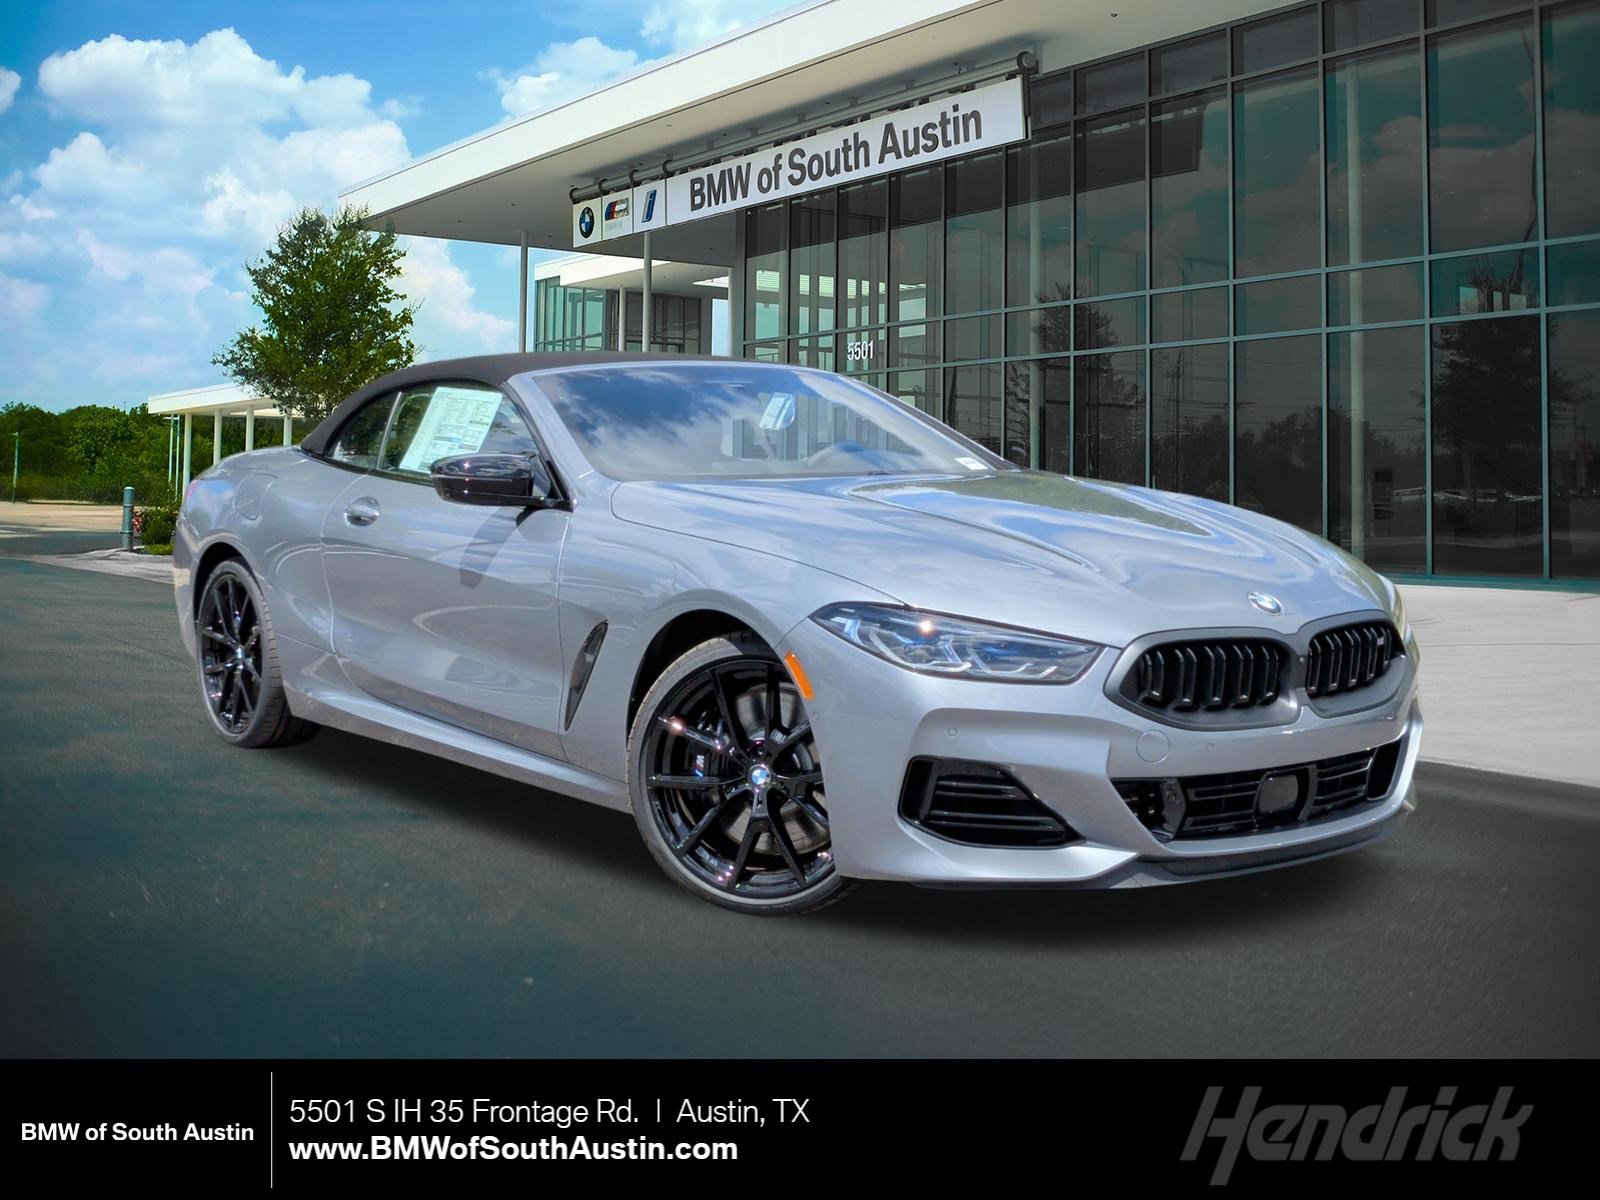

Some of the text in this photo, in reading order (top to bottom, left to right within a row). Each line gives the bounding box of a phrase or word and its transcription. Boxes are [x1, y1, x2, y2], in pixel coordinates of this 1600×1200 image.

[689, 162, 752, 212] BMW
[757, 153, 782, 194] of
[787, 131, 870, 186] South
[877, 103, 983, 164] Austin
[847, 340, 873, 360] 5501
